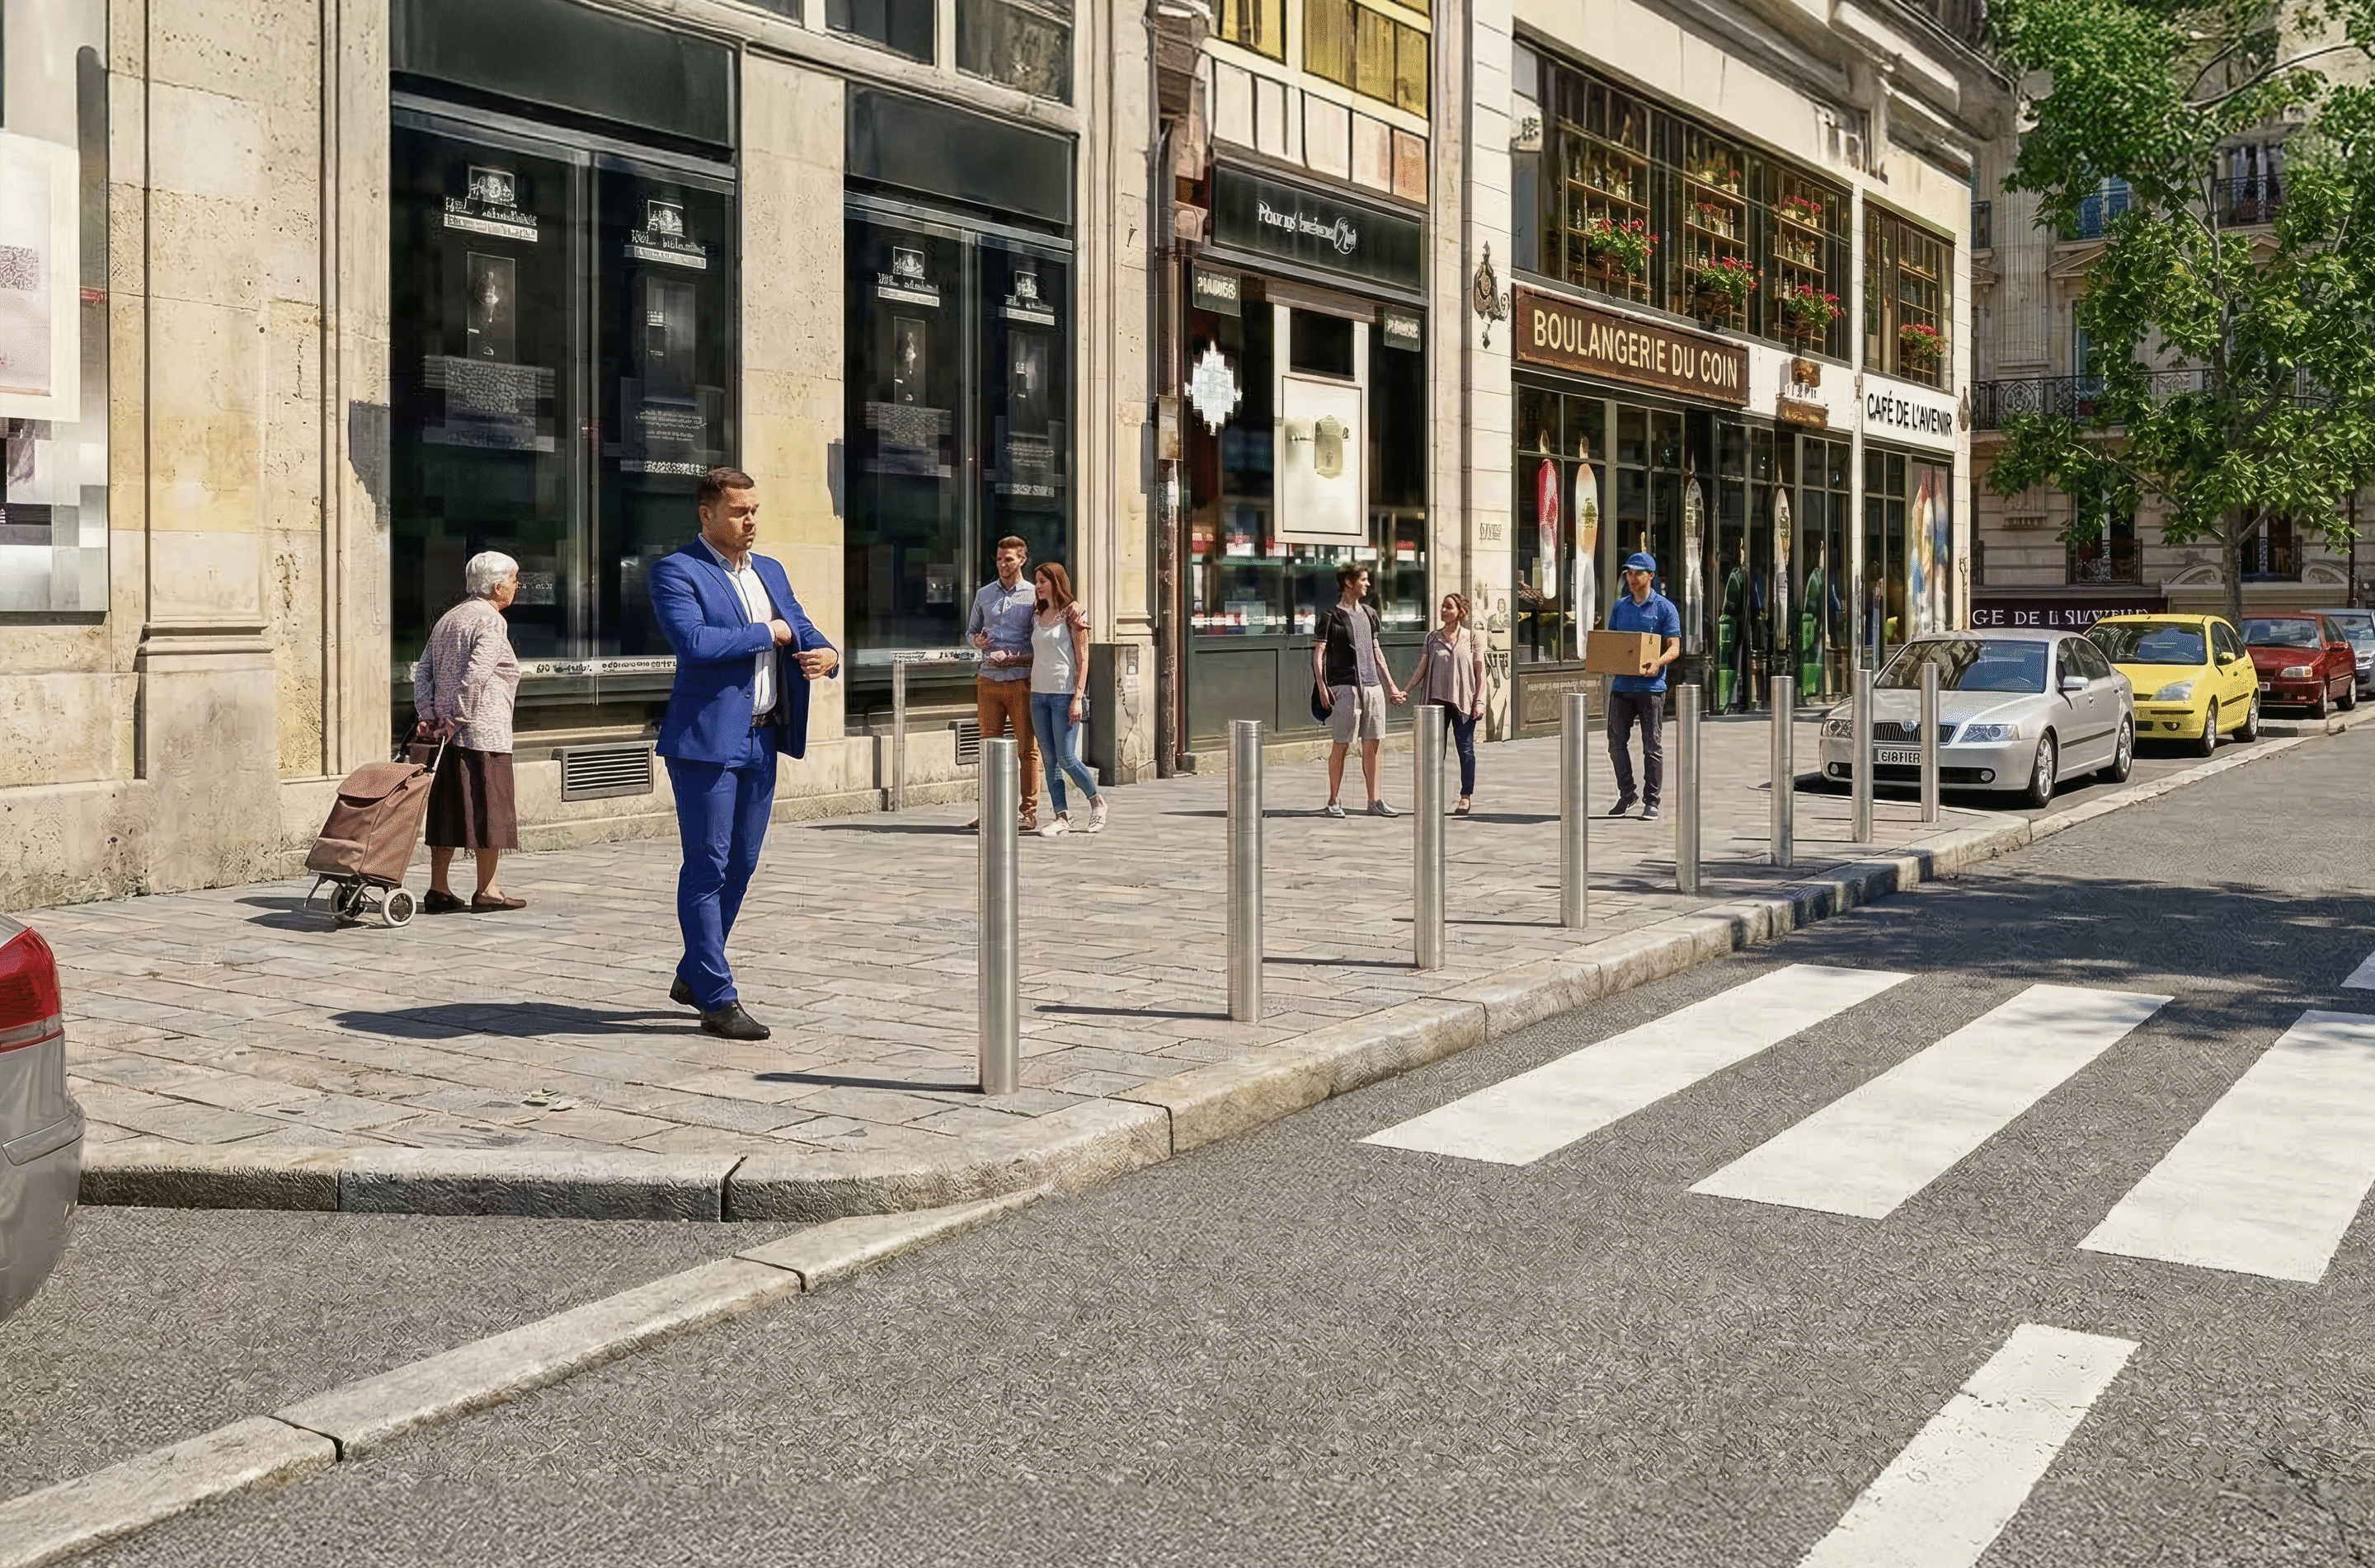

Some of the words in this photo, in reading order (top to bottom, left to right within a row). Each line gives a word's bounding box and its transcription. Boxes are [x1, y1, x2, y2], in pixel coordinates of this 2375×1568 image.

[1534, 309, 1667, 373] BOULANGERIE
[1672, 343, 1695, 379] DU
[1700, 350, 1738, 390] COIN
[1868, 391, 1893, 424] CAFÉ
[1896, 400, 1909, 428] DE
[1972, 609, 2005, 625] GE
[2014, 611, 2040, 625] DE
